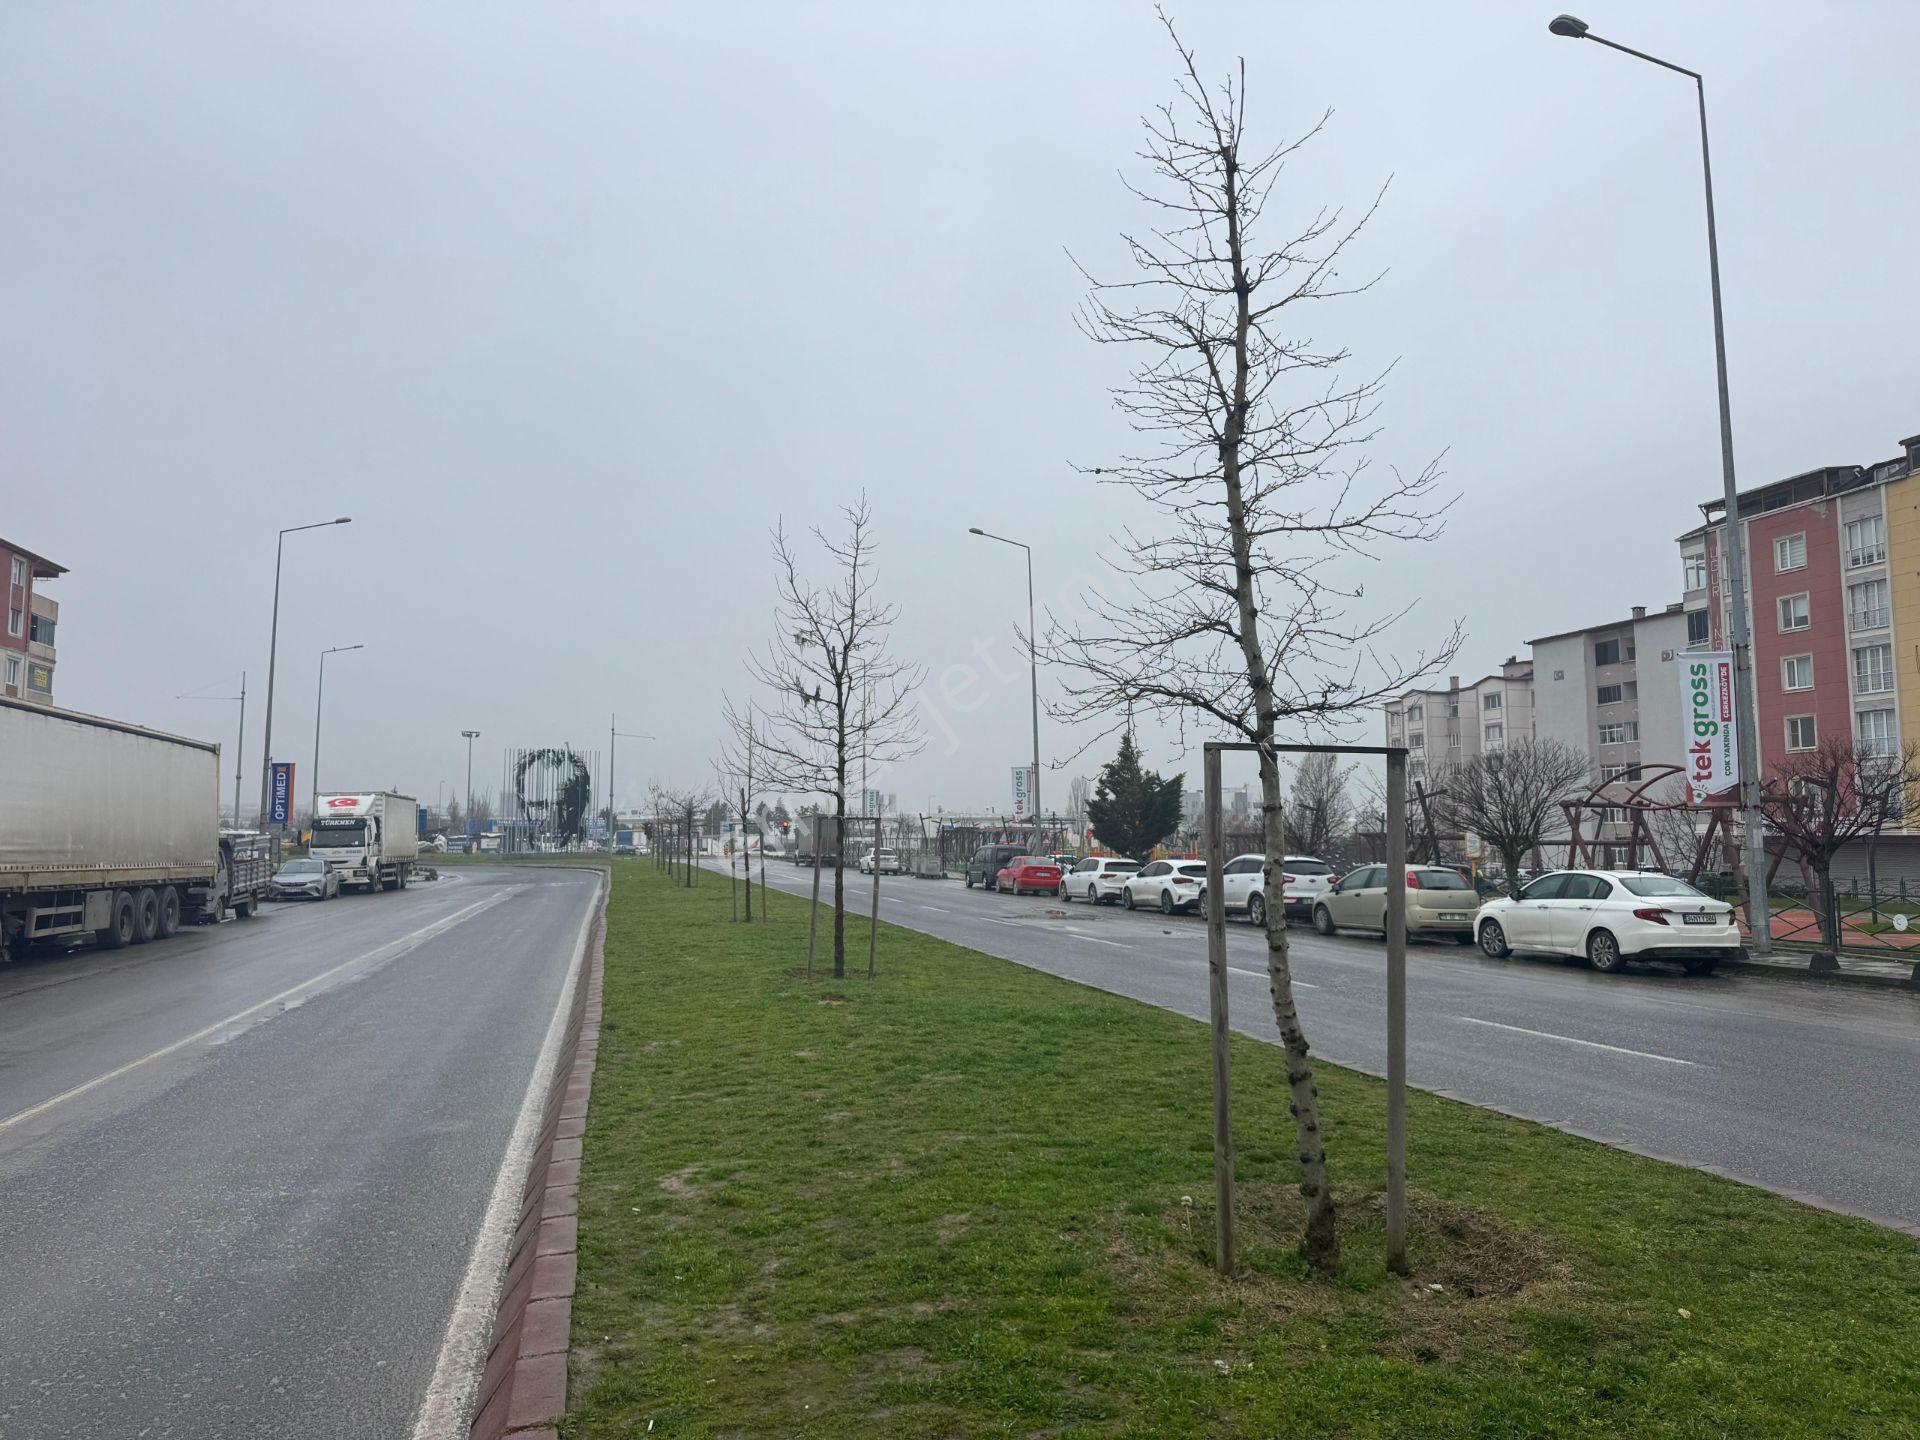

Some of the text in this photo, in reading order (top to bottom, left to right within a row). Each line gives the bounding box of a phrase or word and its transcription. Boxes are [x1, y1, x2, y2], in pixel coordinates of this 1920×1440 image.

[1721, 667, 1732, 776] ÇOK YAKINDA ÇERKEZKÖY'DE
